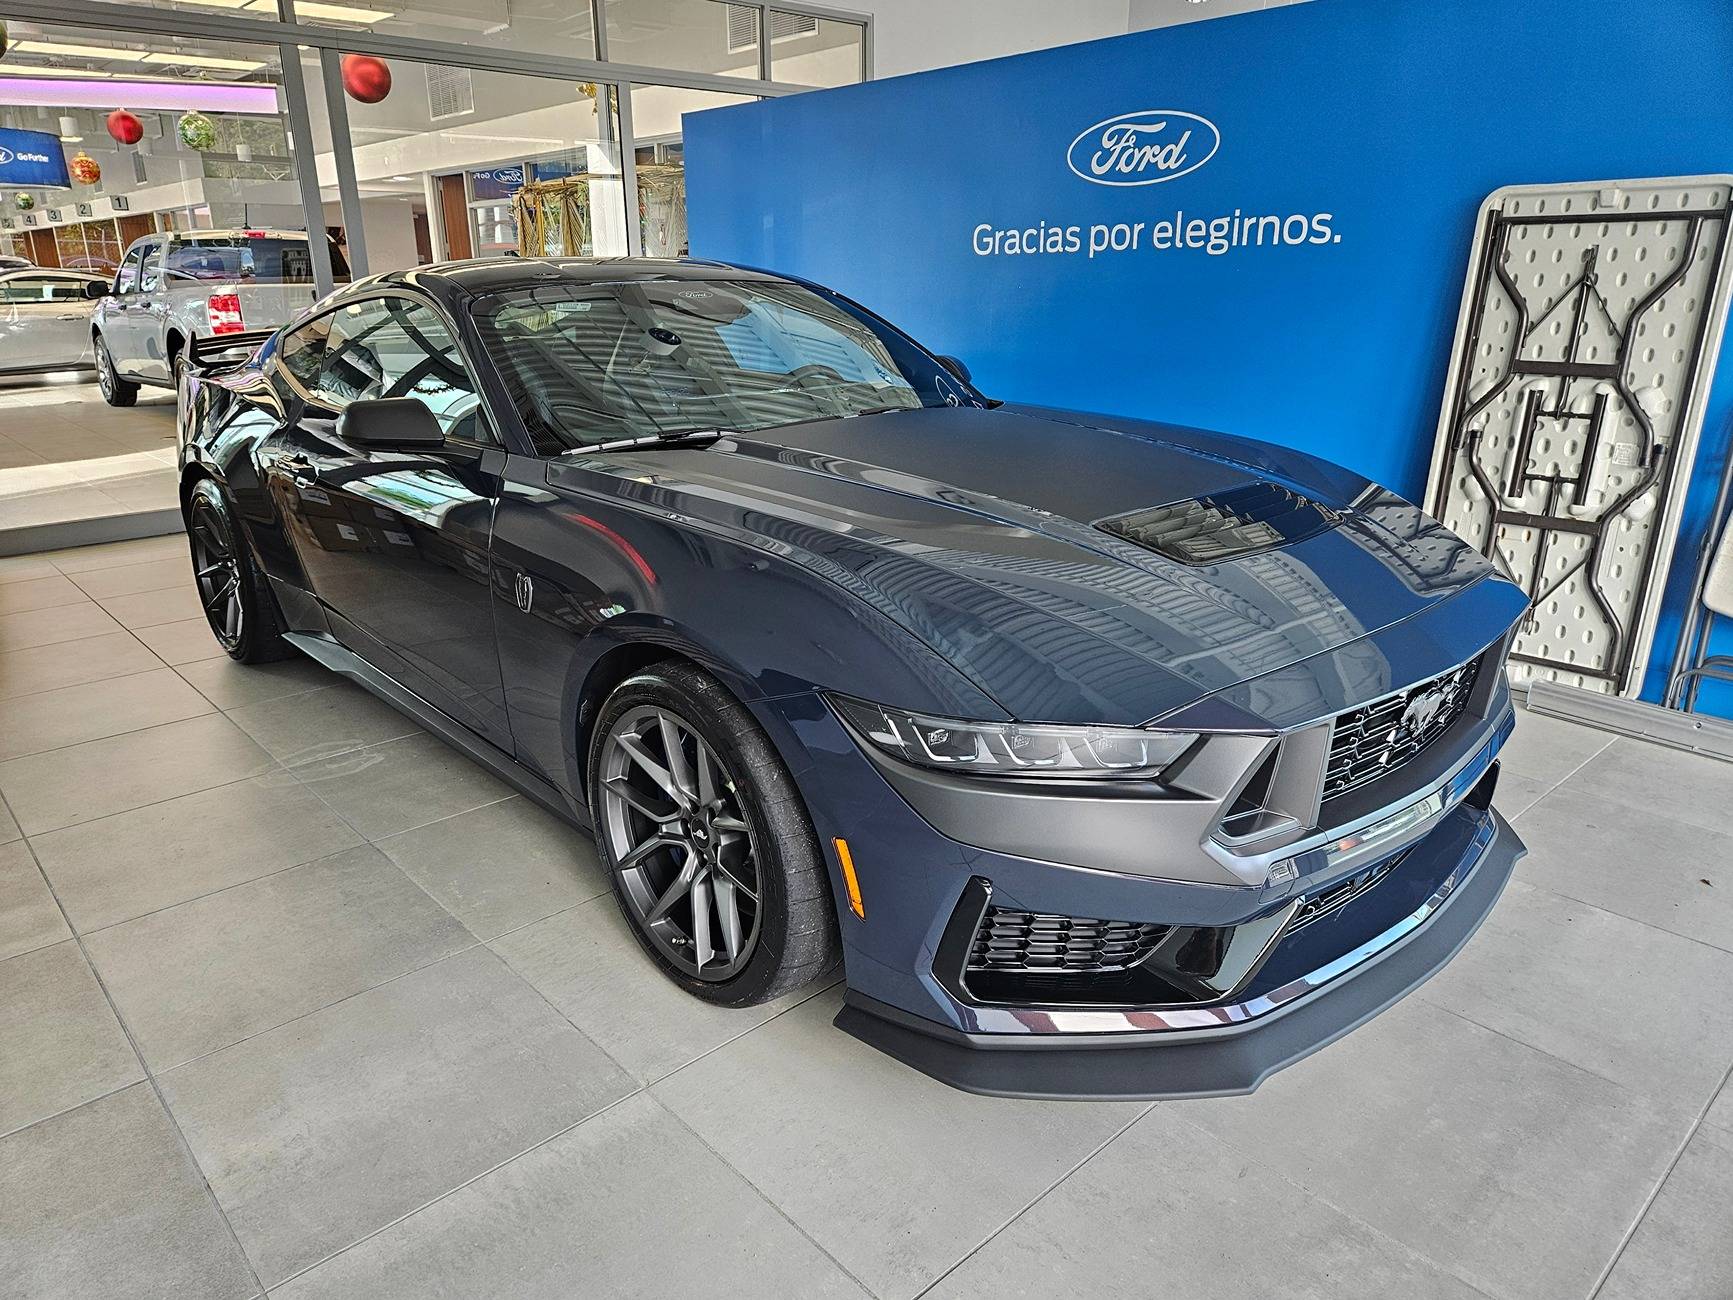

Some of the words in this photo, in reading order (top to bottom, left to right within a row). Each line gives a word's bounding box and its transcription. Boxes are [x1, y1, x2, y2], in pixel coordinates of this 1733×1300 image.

[17, 152, 28, 161] Go
[1090, 121, 1191, 175] Ford
[972, 221, 1080, 256] Gracias
[1088, 223, 1145, 258] por
[1154, 210, 1342, 255] elegirnos.
